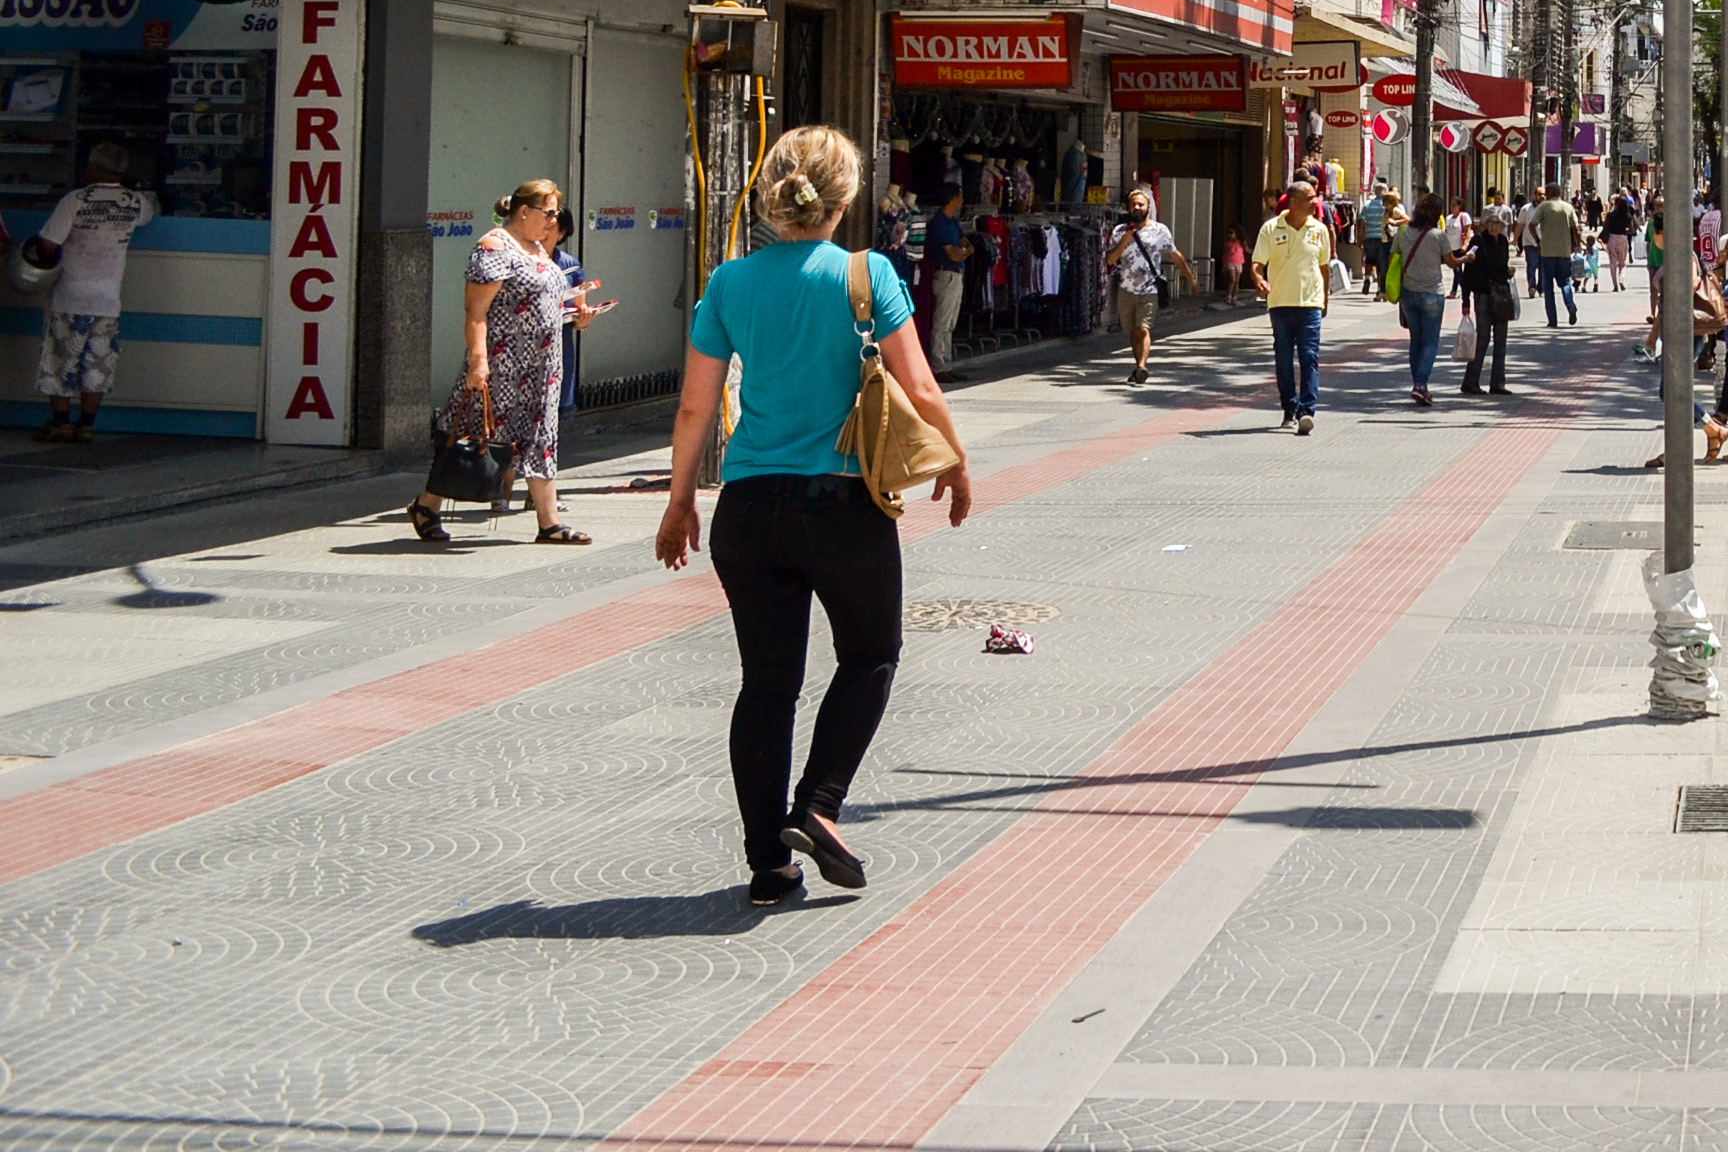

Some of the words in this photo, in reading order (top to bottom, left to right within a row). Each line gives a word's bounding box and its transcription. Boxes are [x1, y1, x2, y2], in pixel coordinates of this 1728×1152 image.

[241, 14, 278, 32] São
[902, 35, 1061, 61] NORMAN
[937, 66, 1025, 83] Magazine
[1117, 70, 1238, 90] NORMAN
[1383, 84, 1399, 95] TOP
[1401, 84, 1416, 95] LIN
[1144, 94, 1213, 107] Magazine
[284, 1, 342, 420] FARMÁCIA
[427, 211, 474, 222] FARMÁCIAS
[599, 206, 635, 216] FARMÁCIAS
[447, 222, 474, 237] João
[596, 217, 614, 230] São
[615, 216, 635, 230] João
